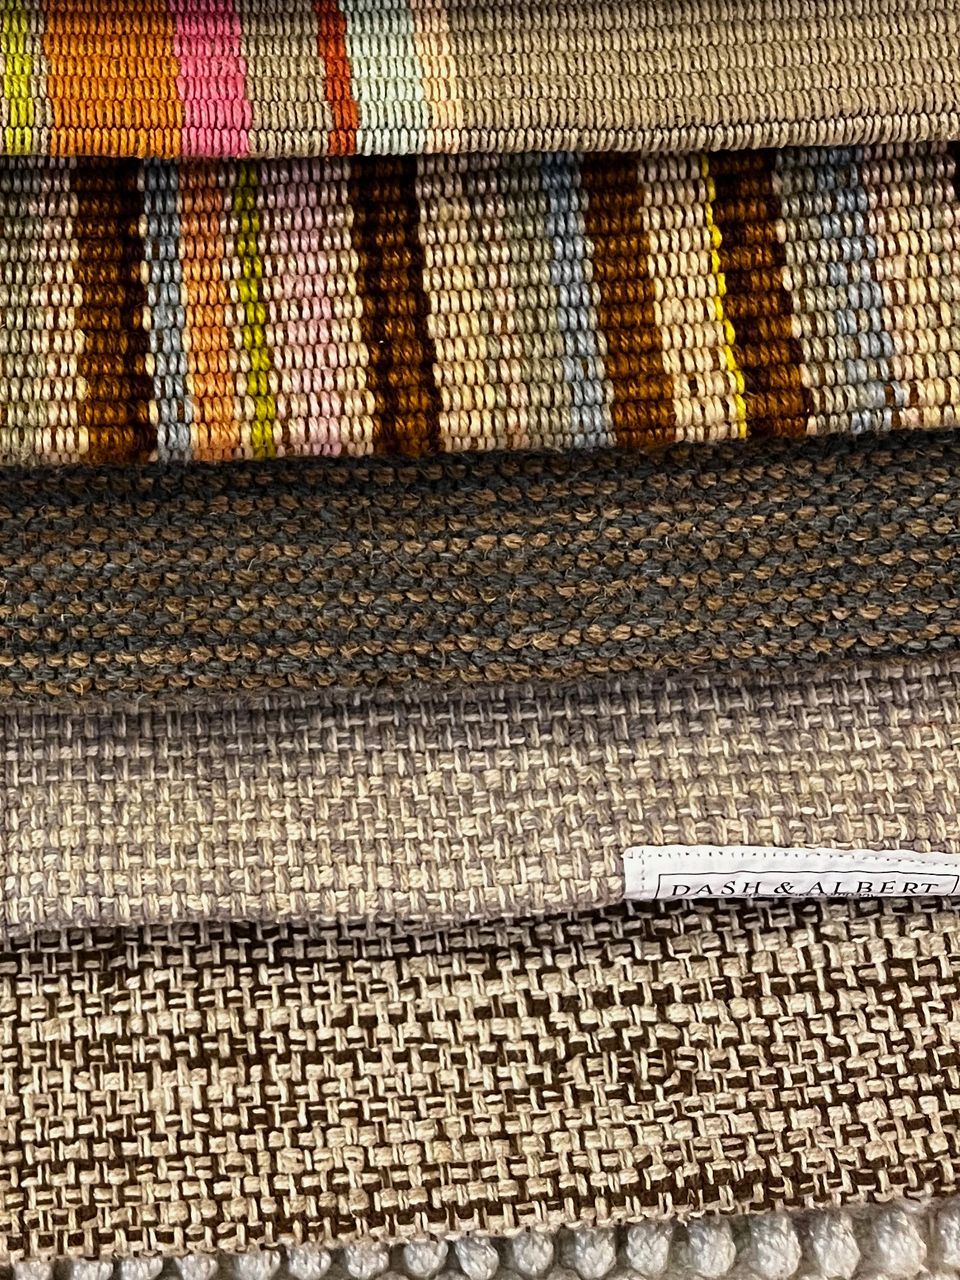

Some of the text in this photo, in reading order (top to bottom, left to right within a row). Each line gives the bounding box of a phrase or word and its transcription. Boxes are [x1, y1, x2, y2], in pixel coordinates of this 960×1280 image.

[671, 880, 762, 896] DASH
[773, 881, 795, 895] &
[807, 880, 939, 895] ALBERT
